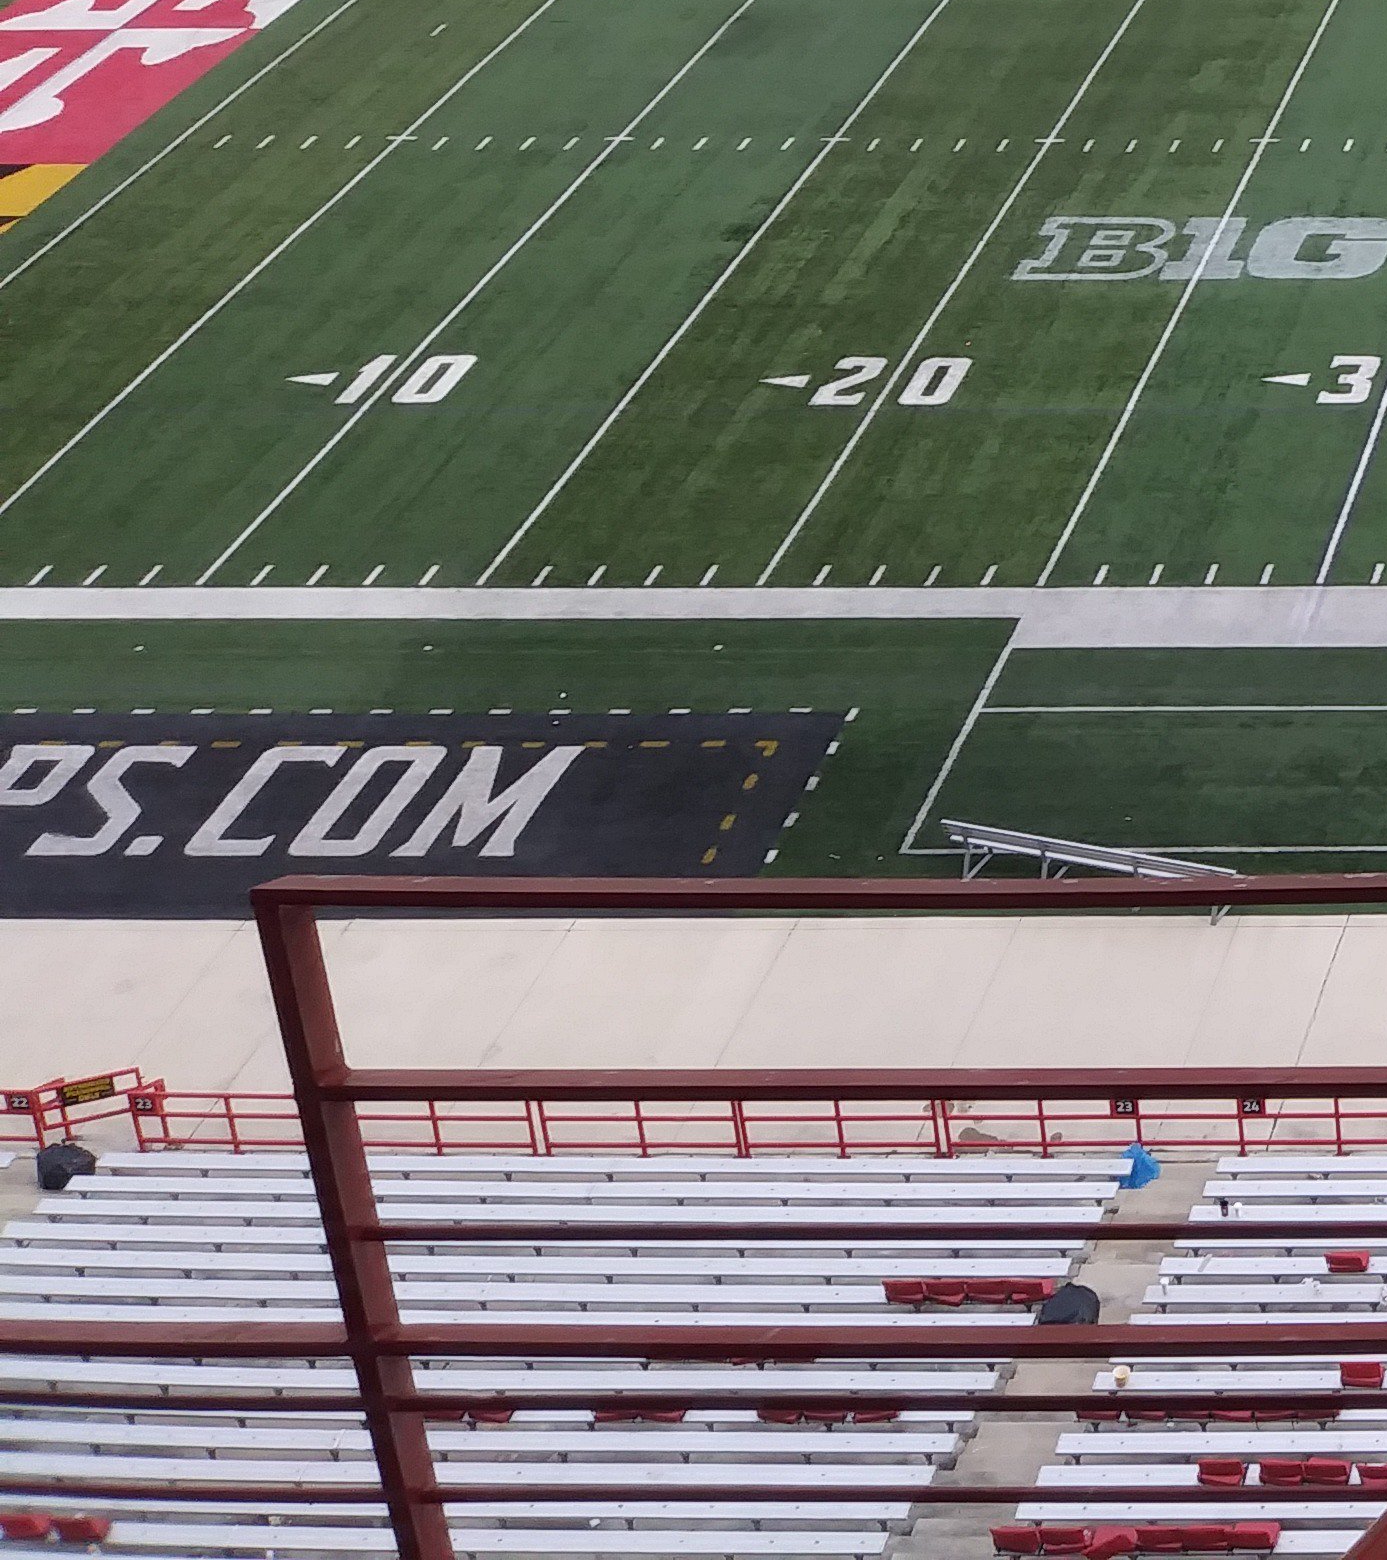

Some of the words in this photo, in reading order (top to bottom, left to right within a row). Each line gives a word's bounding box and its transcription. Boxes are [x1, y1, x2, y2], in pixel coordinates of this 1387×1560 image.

[335, 354, 477, 404] 10
[807, 357, 973, 406] 20
[11, 1096, 28, 1108] 22
[135, 1098, 152, 1110] 23
[1116, 1101, 1134, 1112] 23
[1242, 1101, 1260, 1112] 24
